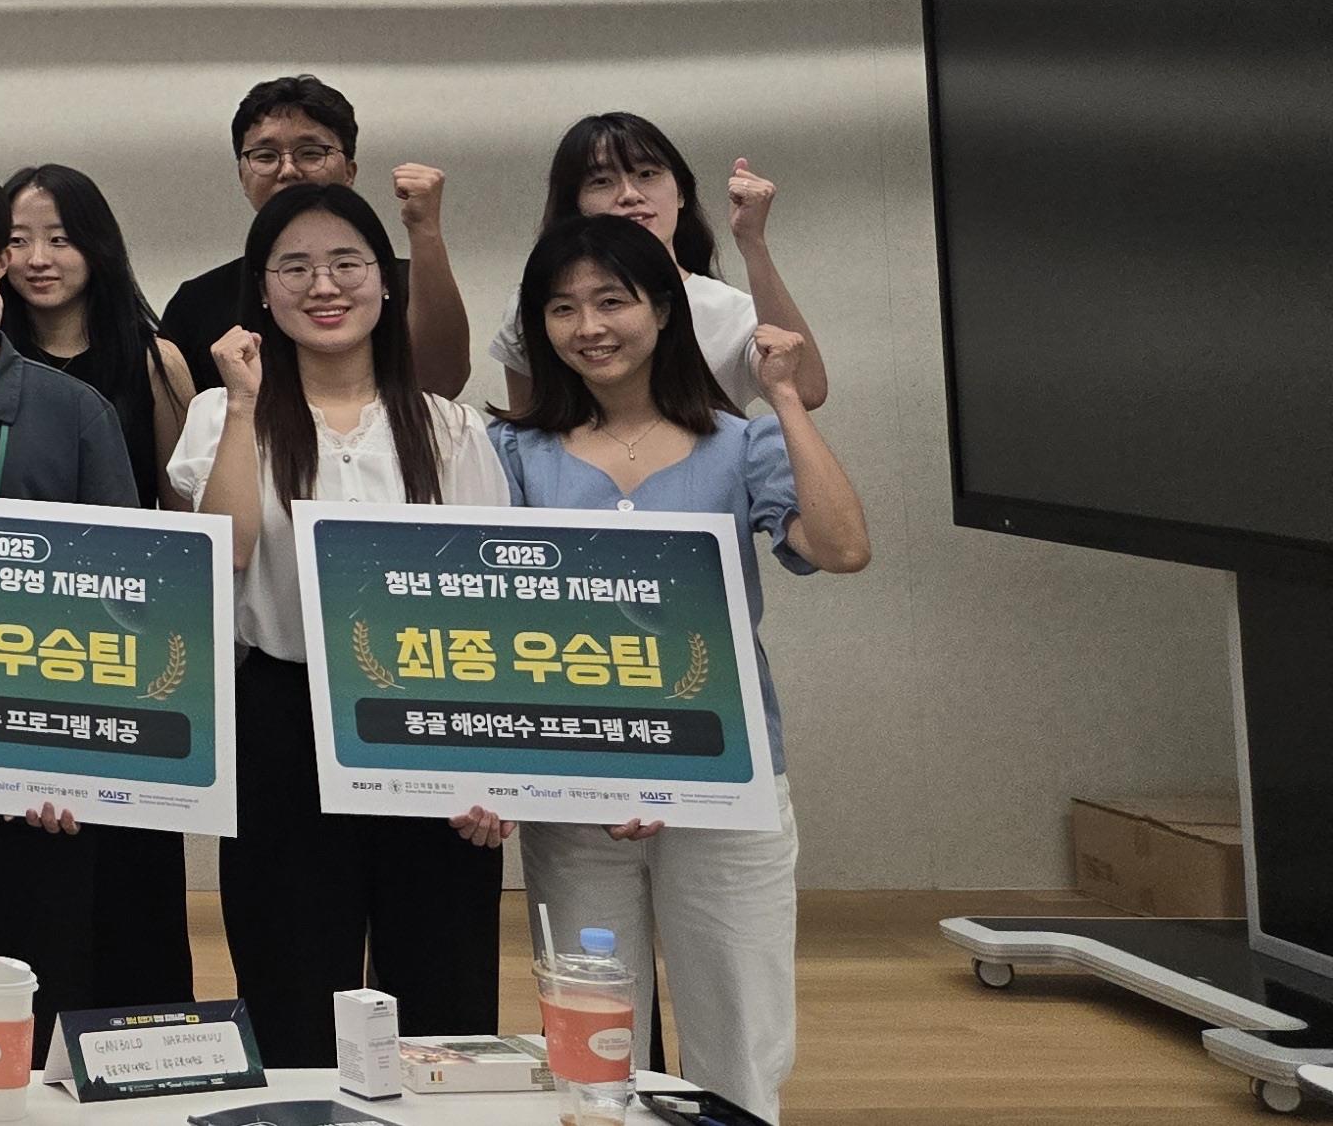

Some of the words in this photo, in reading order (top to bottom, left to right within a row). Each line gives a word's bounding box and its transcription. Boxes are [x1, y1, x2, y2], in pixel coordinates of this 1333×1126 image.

[495, 547, 545, 565] 2025
[0, 568, 45, 593] 양성
[53, 570, 146, 602] 지원사업
[385, 571, 431, 596] 청년
[438, 573, 508, 598] 창업가
[514, 575, 560, 600] 양성
[567, 577, 660, 603] 지원사업
[396, 628, 496, 681] 최종
[513, 632, 663, 688] 우승팀
[6, 709, 91, 740] 프로그램
[95, 717, 139, 744] 제공
[405, 711, 446, 735] 몽골
[451, 713, 535, 740] 해외연수
[539, 717, 625, 742] 프로그램
[629, 720, 672, 744] 제공
[98, 790, 132, 801] KAIST
[488, 787, 518, 796] 주관기관
[531, 788, 562, 799] Unitef
[639, 792, 673, 802] KAIST
